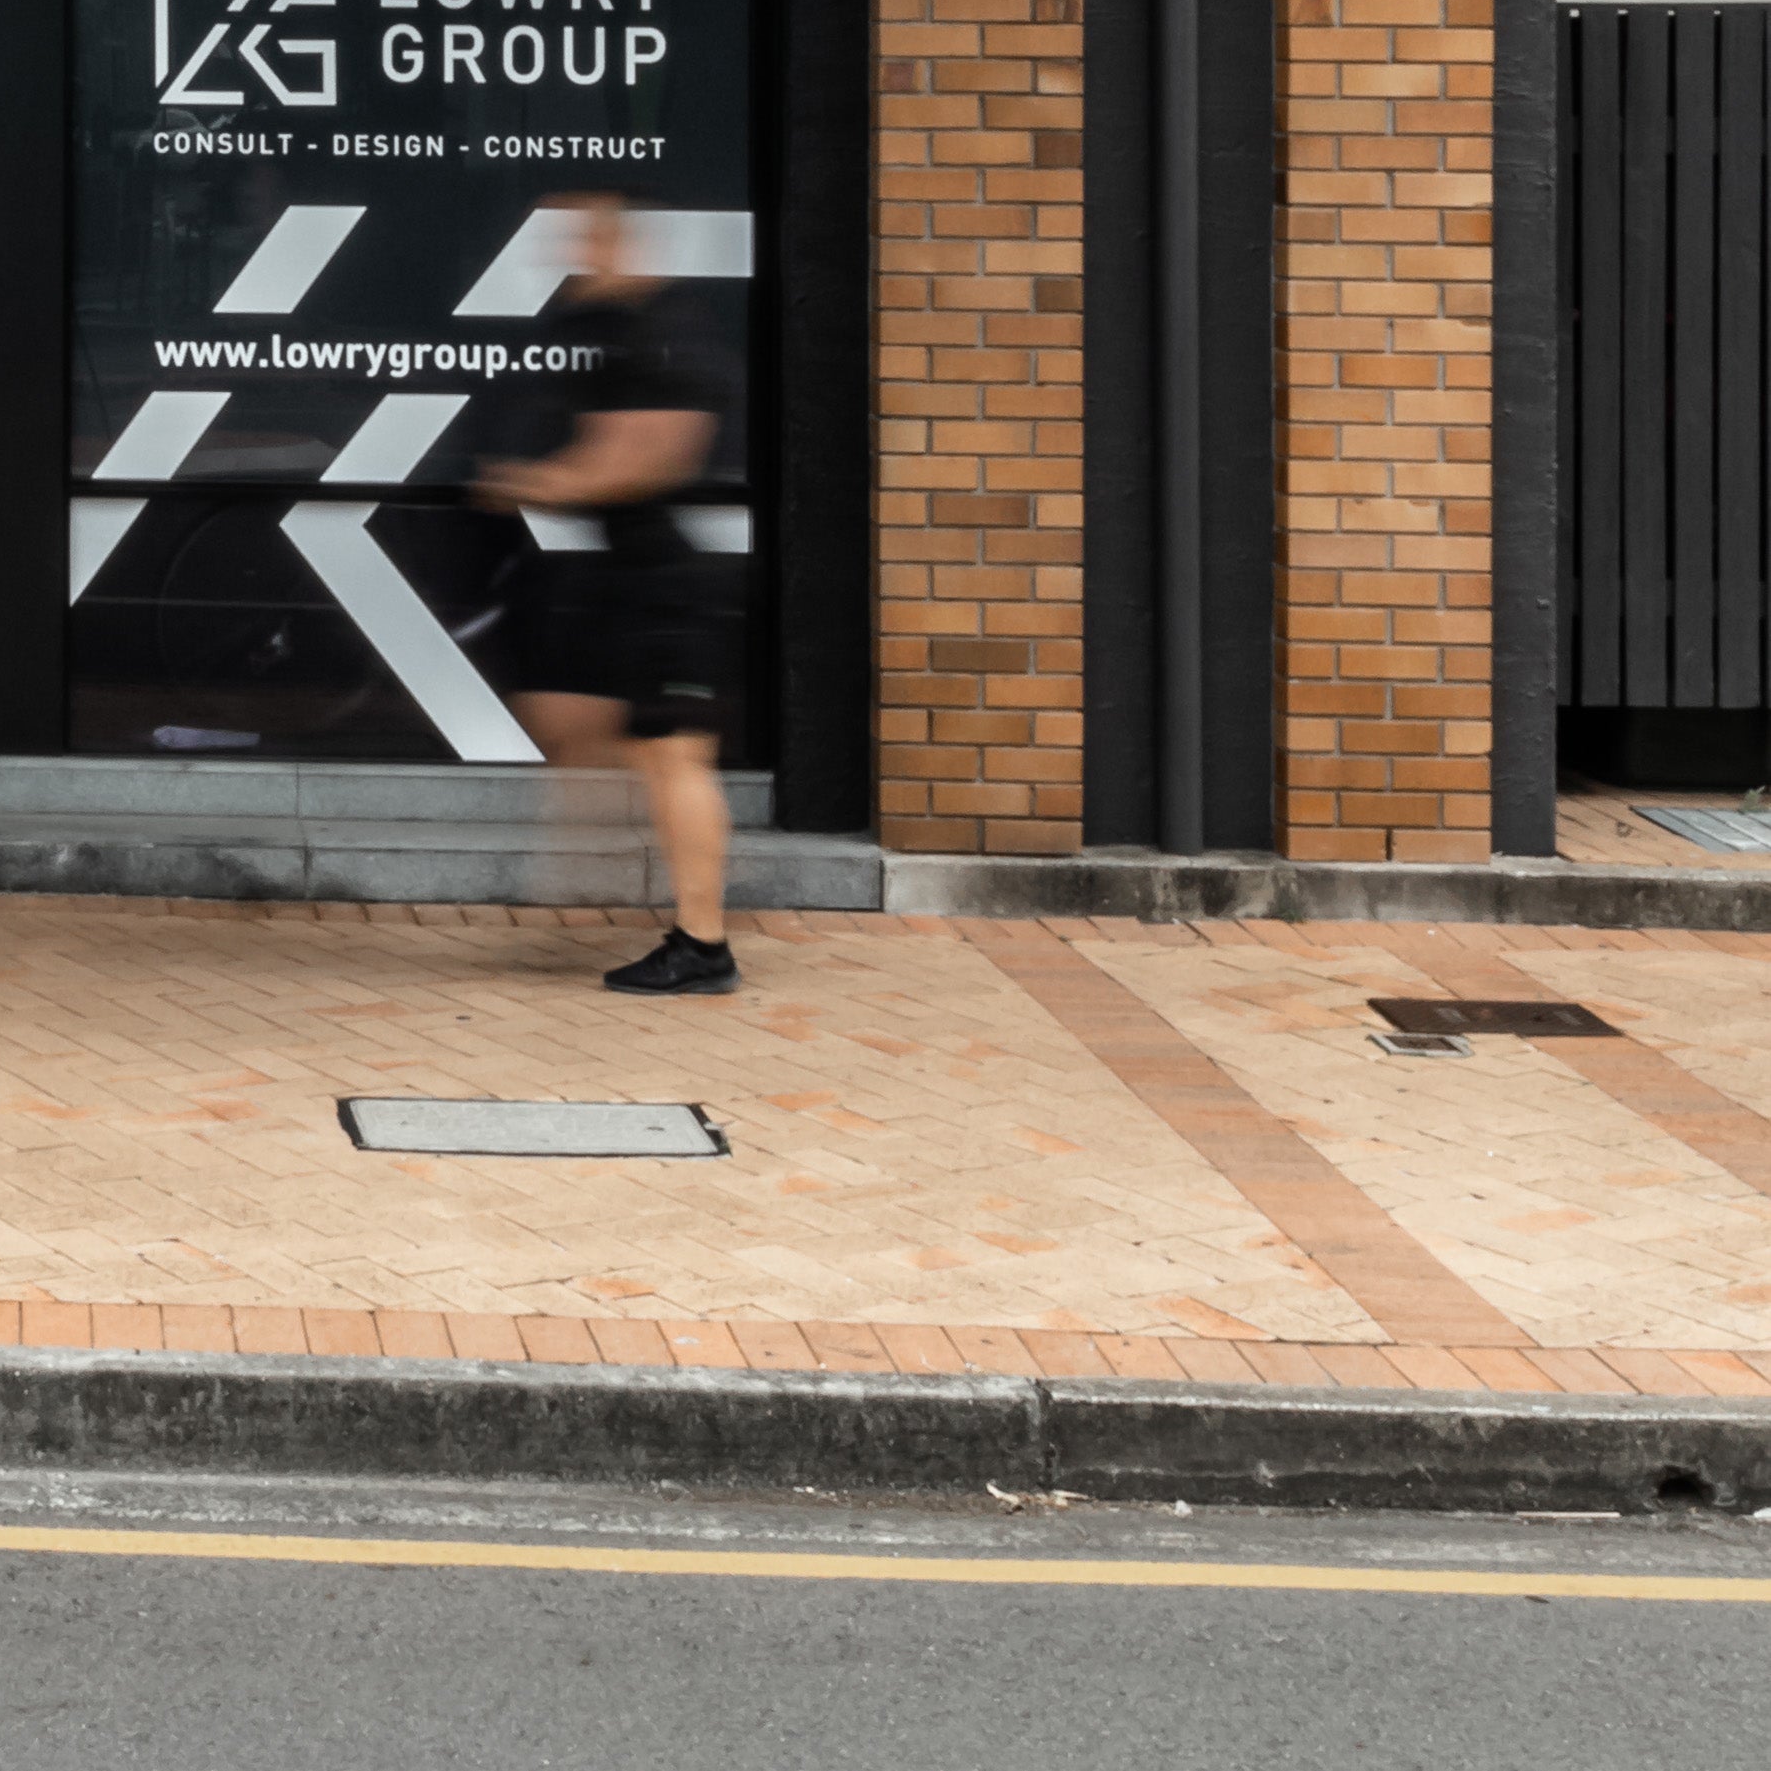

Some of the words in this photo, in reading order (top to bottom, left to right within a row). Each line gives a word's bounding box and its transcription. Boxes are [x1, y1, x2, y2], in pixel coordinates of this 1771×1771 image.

[381, 24, 667, 85] GROUP
[153, 132, 293, 155] CONSULT
[333, 134, 444, 157] DESIGN
[484, 136, 666, 159] CONSTRUCT
[154, 334, 605, 379] www.lowrygroup.com
